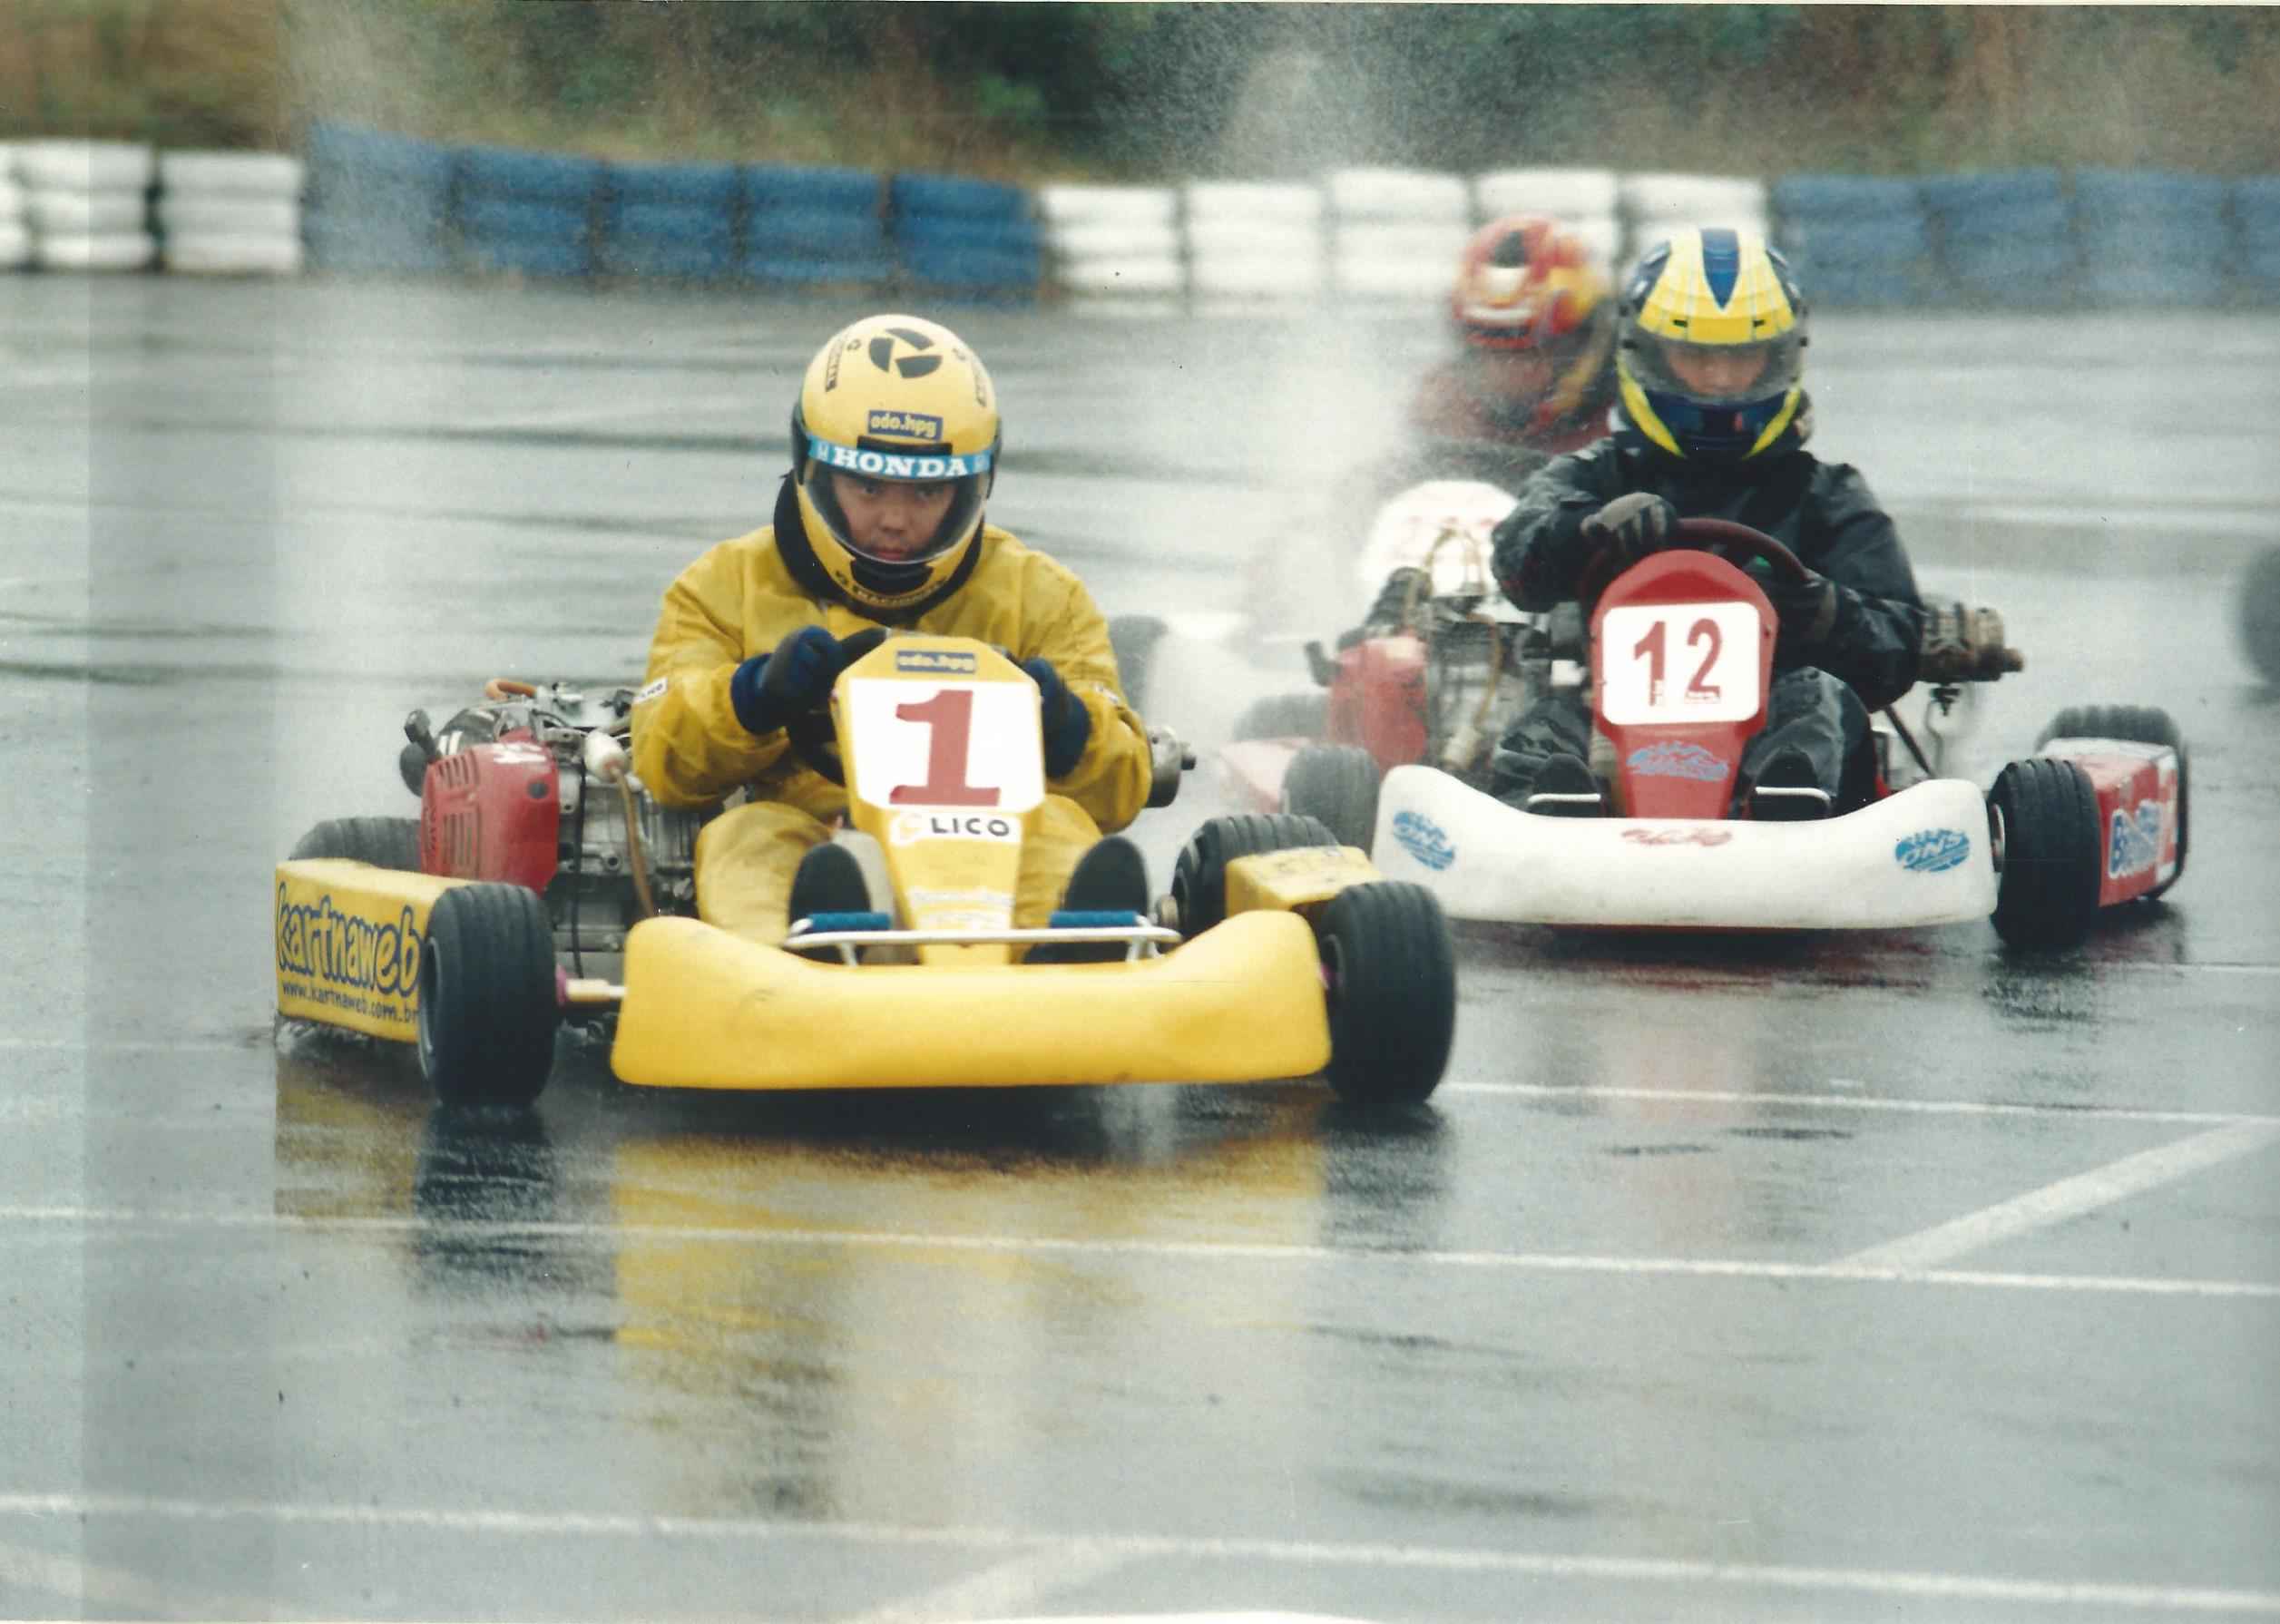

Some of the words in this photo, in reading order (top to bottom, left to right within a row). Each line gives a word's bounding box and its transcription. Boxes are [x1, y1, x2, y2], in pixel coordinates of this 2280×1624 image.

[834, 447, 967, 476] HONDA
[1634, 618, 1721, 706] 12
[889, 690, 1001, 807] 1
[931, 817, 1009, 836] LICO
[277, 881, 420, 997] kartnaweb
